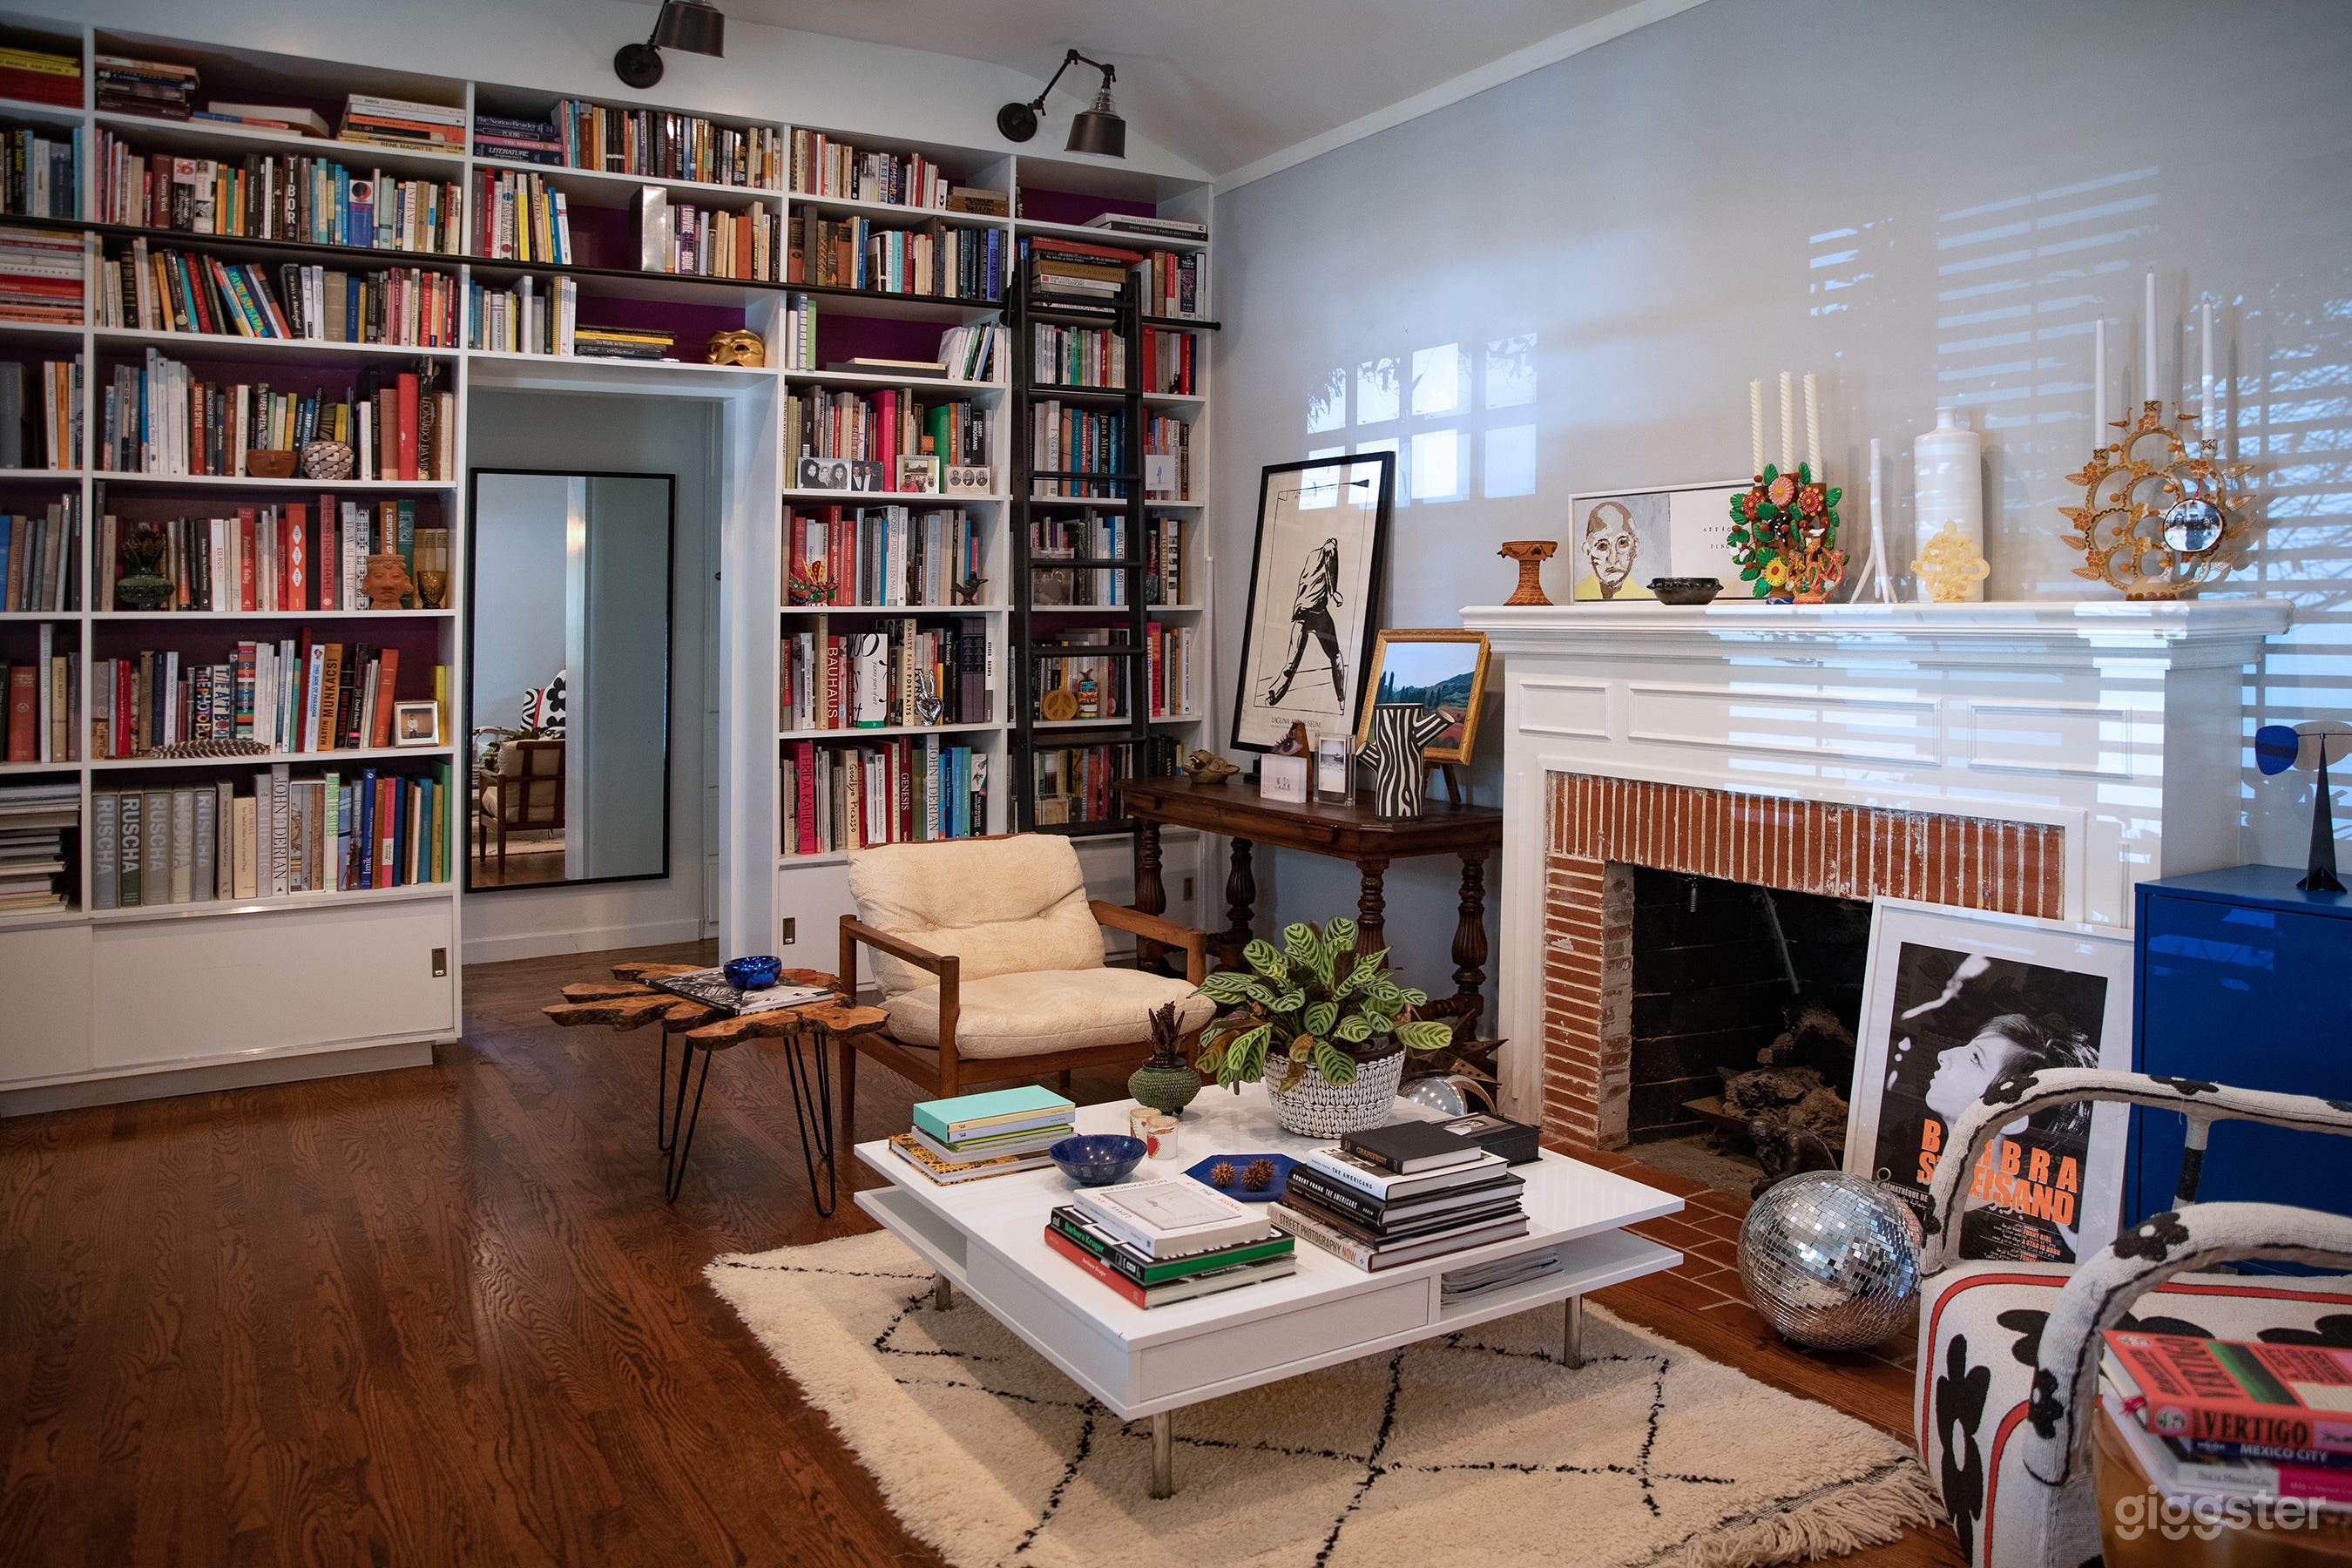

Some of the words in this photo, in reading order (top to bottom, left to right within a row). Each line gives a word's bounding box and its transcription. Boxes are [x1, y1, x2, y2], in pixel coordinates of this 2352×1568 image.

[489, 146, 530, 158] LITERATURE
[287, 157, 296, 225] TIBOR
[407, 186, 416, 225] INFERNO
[533, 194, 542, 221] AZTECS
[682, 207, 694, 233] LOUVRE
[682, 252, 693, 270] BOOK
[239, 296, 265, 334] KUSAMA
[292, 301, 301, 329] Mockingbird
[258, 394, 267, 411] PAPER
[422, 397, 432, 442] LEONARDO
[258, 415, 267, 431] PETAL
[1100, 415, 1109, 435] Joan
[1050, 428, 1058, 468] INGRES
[323, 523, 332, 555] SISTINE
[322, 557, 332, 593] CHAPEL
[325, 659, 338, 717] MUNKACSI
[828, 647, 839, 719] BAUHAUS
[1152, 660, 1160, 710] BOHEMIA
[801, 758, 812, 788] FRIDA
[928, 746, 938, 777] JOHN
[273, 777, 287, 814] JOHN
[328, 776, 340, 801] AVEDON
[847, 764, 858, 797] Goodbye
[901, 773, 909, 811] GENESIS
[326, 813, 339, 837] SIXTIES
[801, 794, 812, 832] KAHLO
[849, 801, 859, 834] Picasso
[928, 787, 938, 833] DERIAN
[96, 800, 115, 875] RUSCHA
[121, 798, 140, 873] RUSCHA
[149, 797, 168, 871] RUSCHA
[173, 796, 192, 869] RUSCHA
[198, 795, 213, 868] RUSCHA
[273, 827, 287, 880] DERIAN
[1922, 1118, 2078, 1194] BRBRA
[1099, 1179, 1169, 1193] INFORMATION
[1342, 1172, 1374, 1190] AMERICANS
[1916, 1150, 2077, 1227] SEISAND
[1333, 1191, 1358, 1210] AMERICANS
[1064, 1223, 1085, 1244] Barbara
[1085, 1233, 1105, 1253] Kruger
[1279, 1213, 1300, 1231] STREET
[1300, 1223, 1342, 1254] PHOTOGRAPHY
[1342, 1246, 1357, 1262] NOW
[2202, 1409, 2309, 1447] VERTIGO
[2239, 1443, 2295, 1460] MEXICO
[2295, 1448, 2328, 1463] CITY
